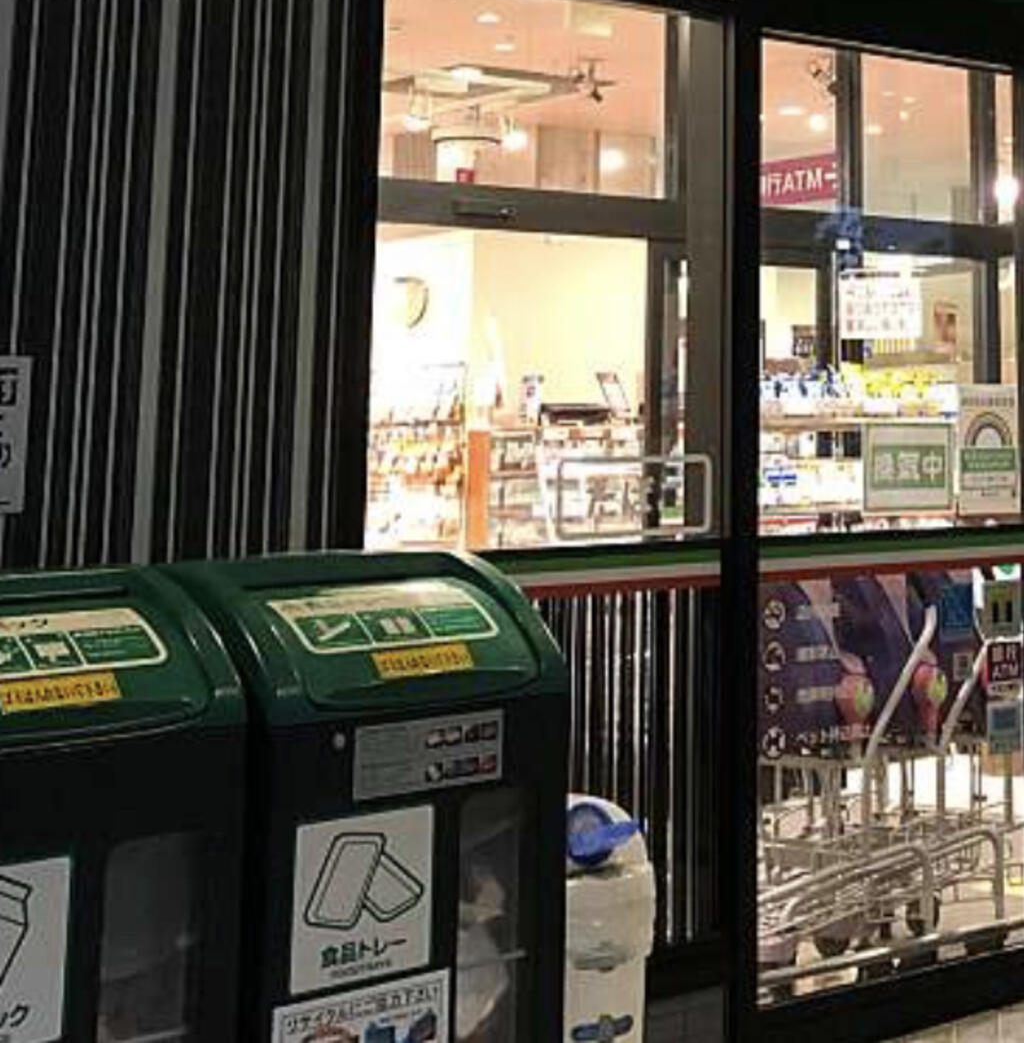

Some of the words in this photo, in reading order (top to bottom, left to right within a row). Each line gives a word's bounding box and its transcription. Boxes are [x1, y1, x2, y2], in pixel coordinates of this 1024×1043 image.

[320, 937, 407, 968] 食品トレー
